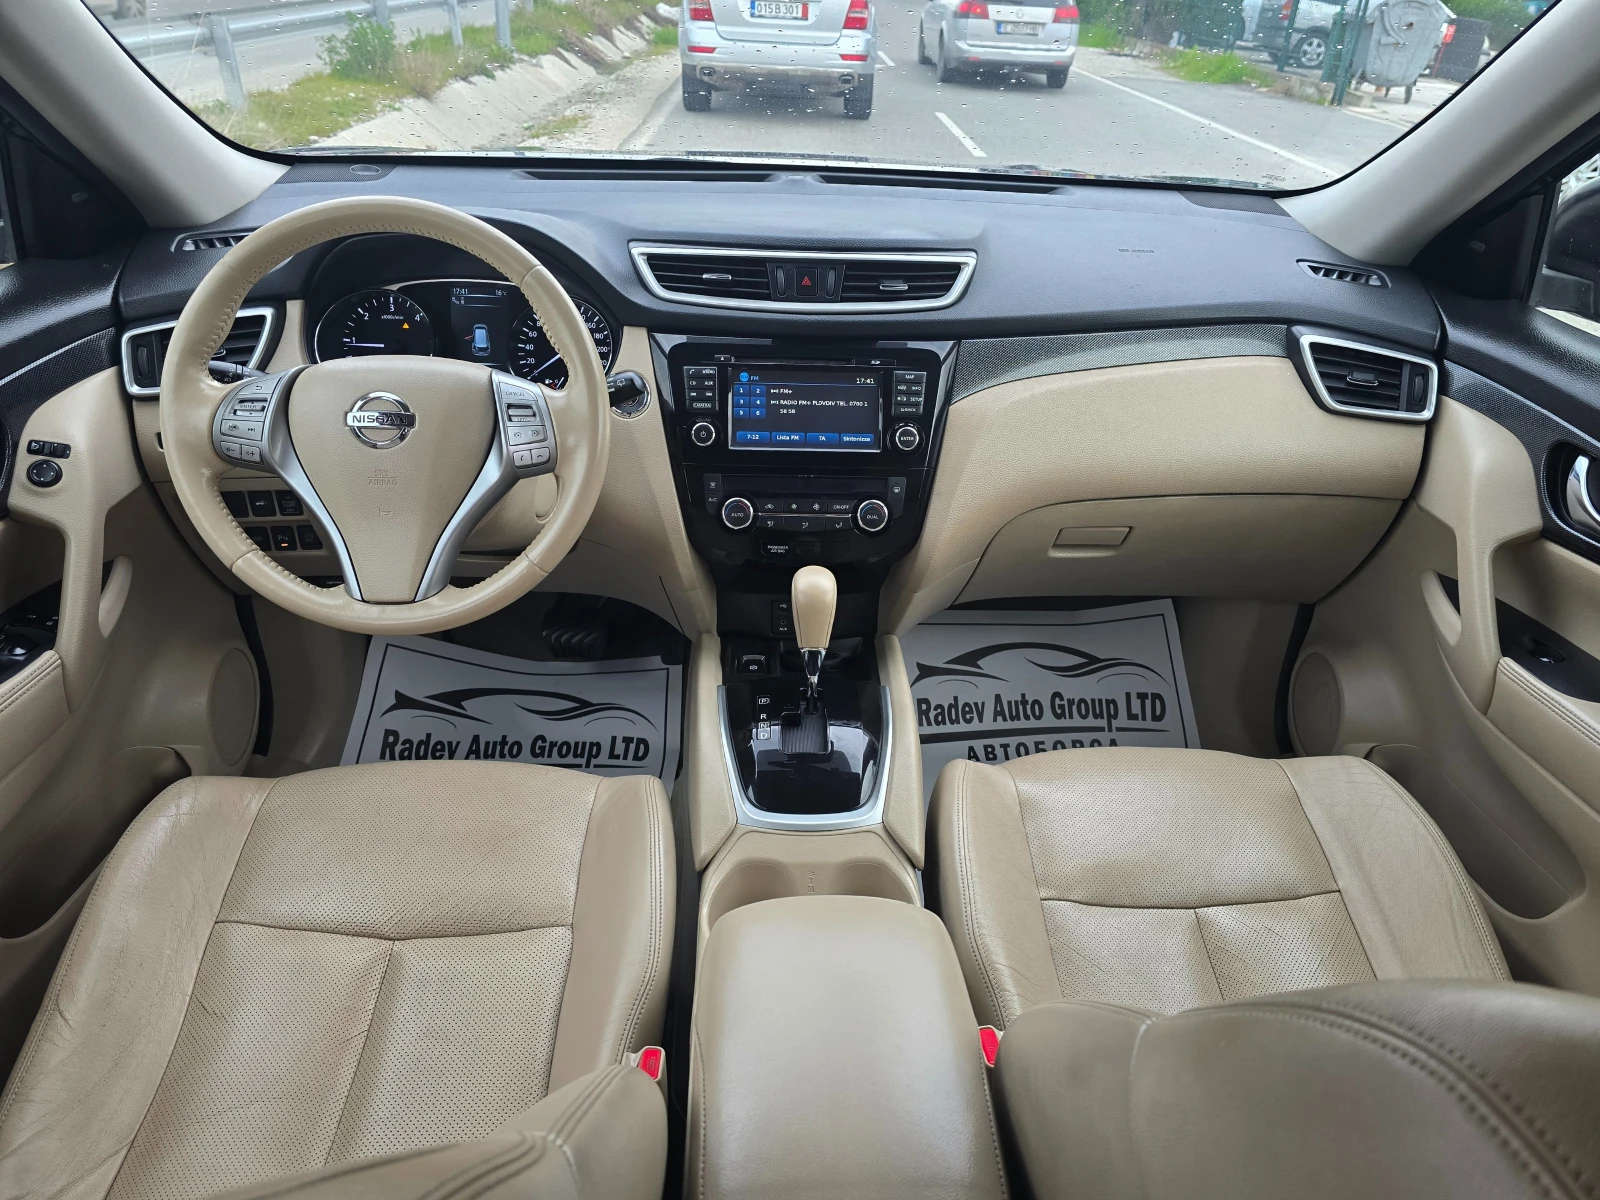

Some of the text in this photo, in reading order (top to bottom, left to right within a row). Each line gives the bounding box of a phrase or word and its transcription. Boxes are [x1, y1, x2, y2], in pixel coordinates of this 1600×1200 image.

[389, 304, 395, 312] 3
[363, 312, 369, 320] 2
[414, 314, 420, 322] 4
[352, 414, 408, 425] NISSAN
[916, 691, 1167, 732] Radev Auto Group LTD
[760, 732, 768, 740] D
[379, 728, 650, 768] Radev Auto Group LTD
